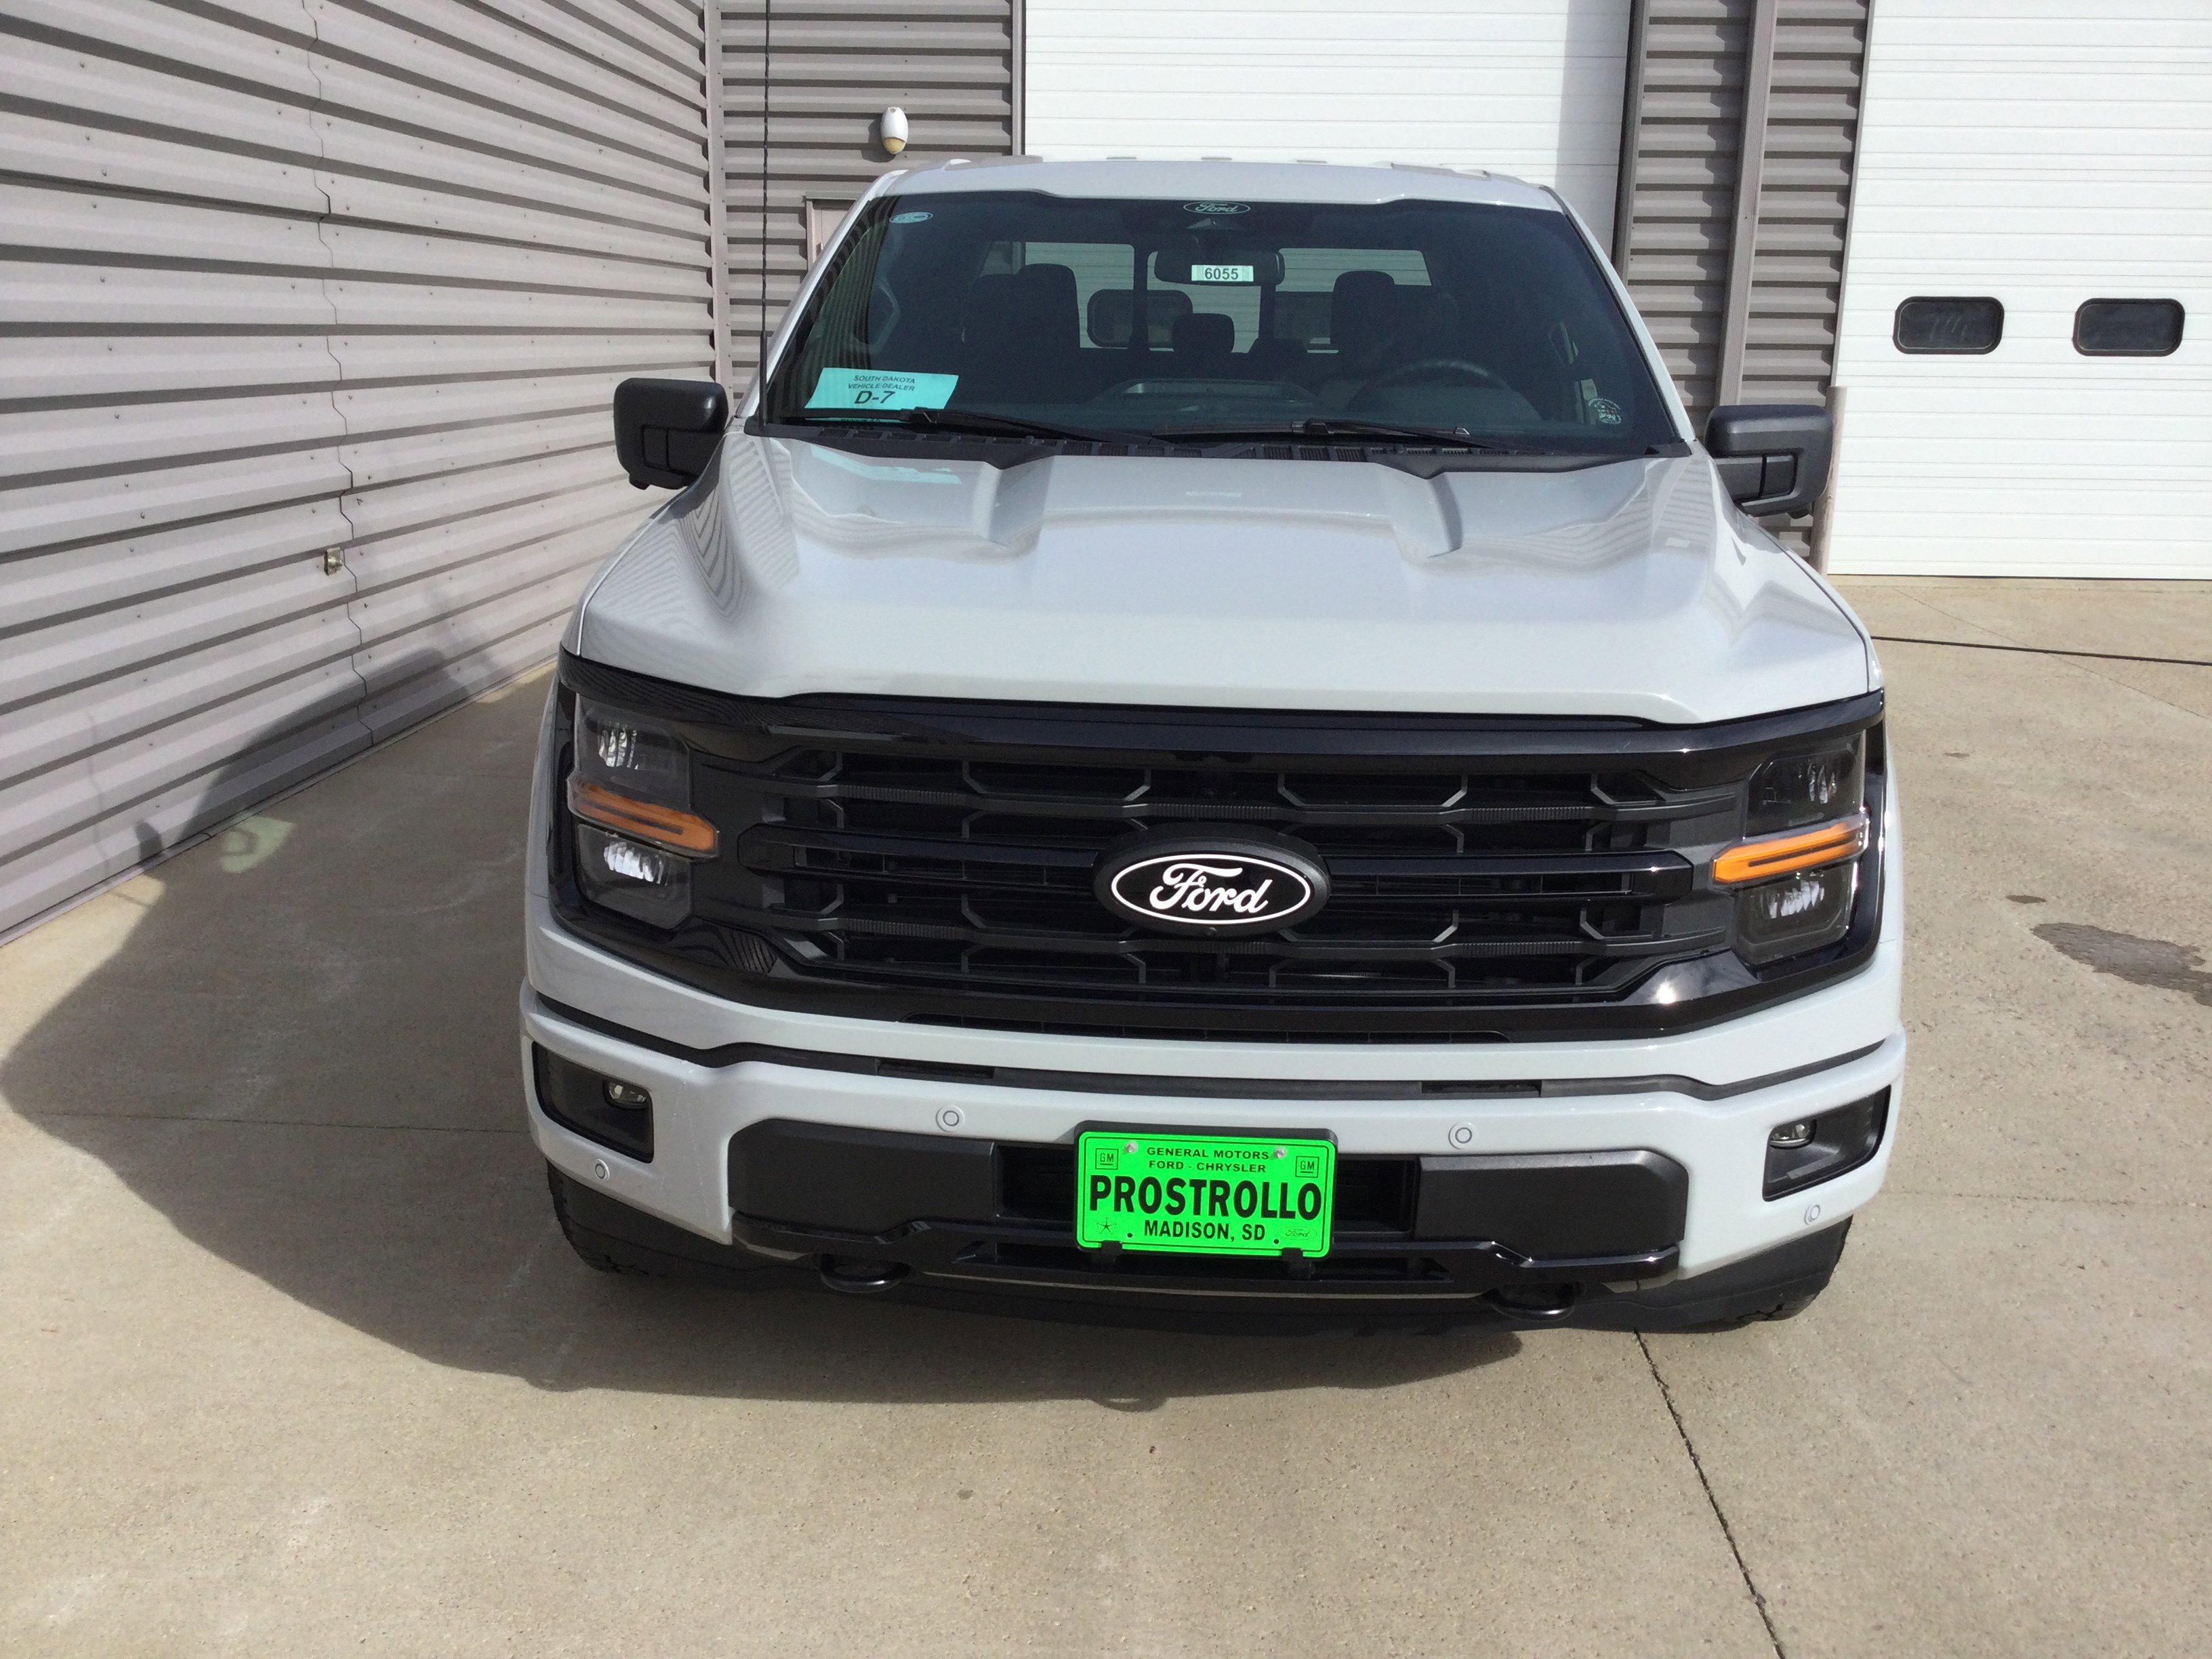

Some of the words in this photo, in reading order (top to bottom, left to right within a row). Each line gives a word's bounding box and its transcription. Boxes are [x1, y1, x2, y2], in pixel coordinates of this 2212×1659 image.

[1195, 203, 1238, 213] Ford
[1204, 268, 1239, 280] 6055
[882, 376, 916, 384] DAKOTA
[882, 383, 916, 391] DEALER
[854, 390, 896, 405] D-7
[1149, 863, 1273, 914] Ford
[1099, 1152, 1114, 1163] GM
[1147, 1147, 1209, 1158] GENERAL
[1213, 1150, 1269, 1160] MOTORS
[1149, 1160, 1184, 1170] FORD
[1196, 1162, 1267, 1173] CHRYSLER
[1299, 1160, 1315, 1170] GM
[1089, 1174, 1322, 1221] PROSTROLLO
[1144, 1219, 1235, 1242] MADISON,
[1242, 1223, 1265, 1241] SD
[1284, 1228, 1311, 1237] Ford
